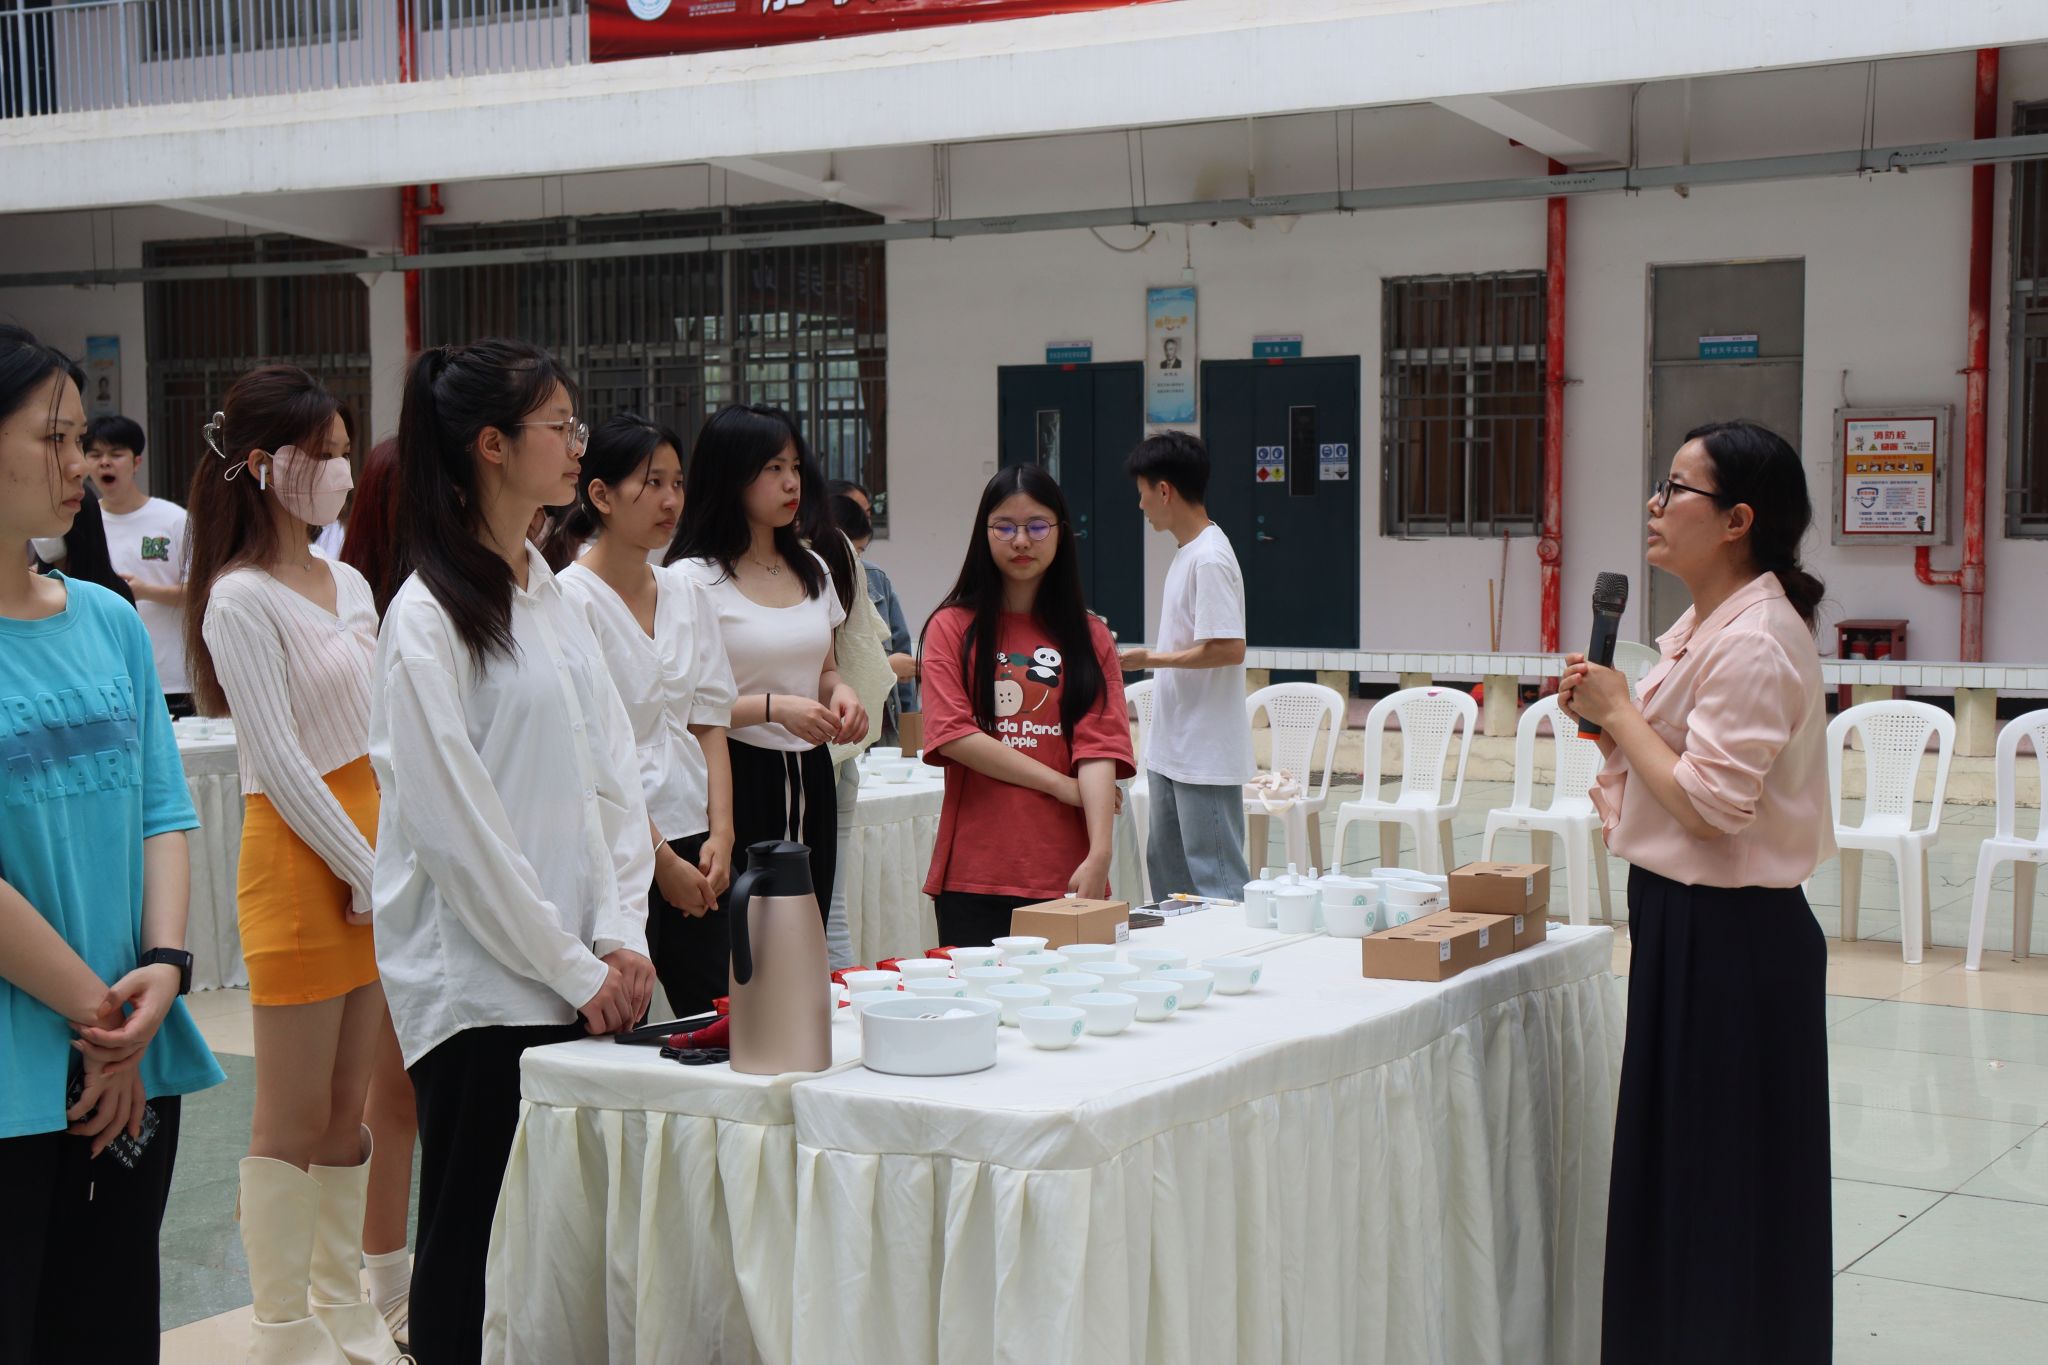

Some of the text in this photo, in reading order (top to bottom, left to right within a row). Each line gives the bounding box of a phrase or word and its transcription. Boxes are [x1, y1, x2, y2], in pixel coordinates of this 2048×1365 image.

[1873, 431, 1906, 440] 消防栓
[1022, 720, 1062, 736] Pand
[1001, 734, 1038, 748] Apple
